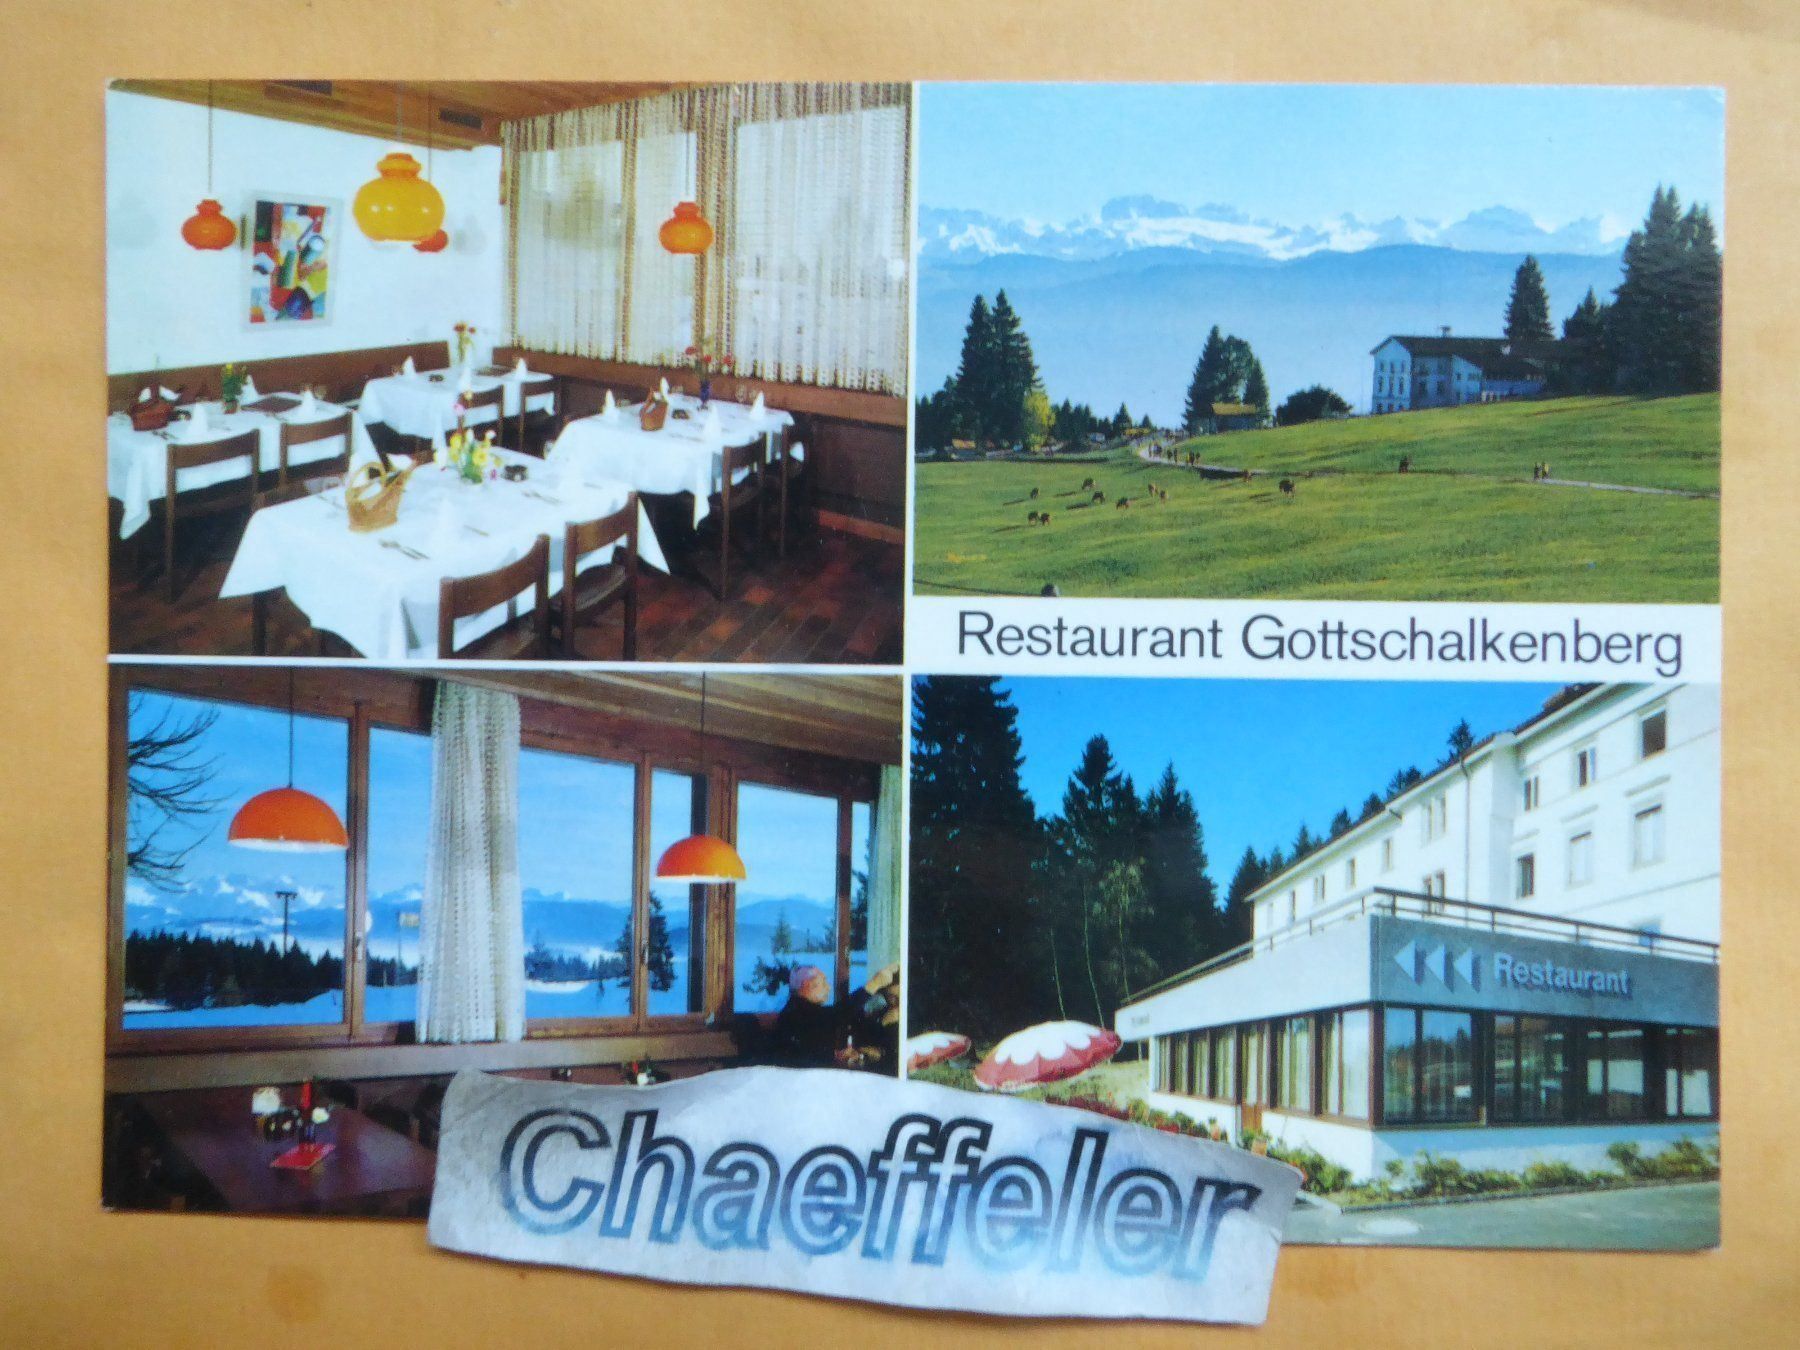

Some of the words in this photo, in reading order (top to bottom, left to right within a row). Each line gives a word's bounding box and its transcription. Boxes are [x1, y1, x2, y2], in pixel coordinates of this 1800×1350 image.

[958, 611, 1222, 659] Restaurant
[1242, 614, 1684, 676] Gottschalkenberg
[1494, 953, 1630, 995] Restaurant
[499, 1108, 1262, 1281] Chaeffeler
